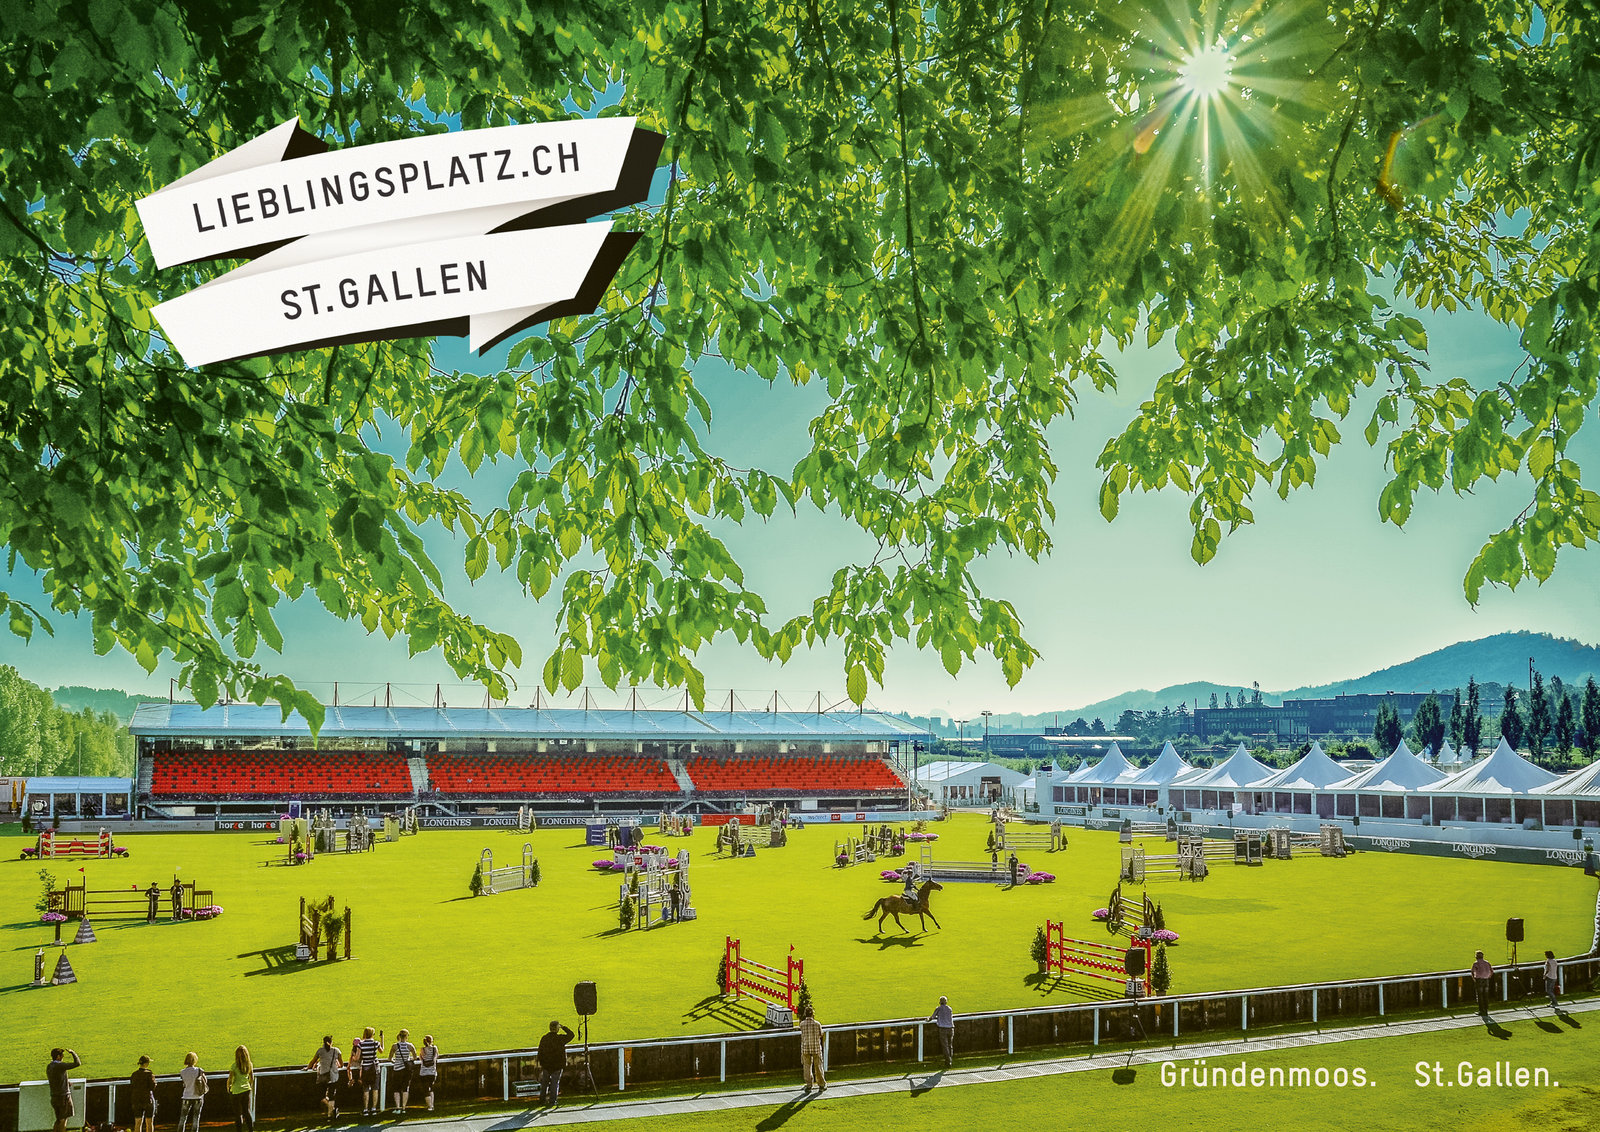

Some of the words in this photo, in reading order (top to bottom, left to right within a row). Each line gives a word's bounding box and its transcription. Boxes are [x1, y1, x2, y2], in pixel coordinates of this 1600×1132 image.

[218, 821, 243, 830] horze
[251, 821, 276, 830] horze
[423, 818, 472, 827] LONGINES
[483, 817, 518, 826] LONGIN
[541, 817, 586, 826] LONGINES
[1371, 837, 1411, 849] LONGINES
[1452, 843, 1497, 855] LONGINES
[1144, 927, 1149, 935] 2
[782, 1013, 790, 1022] A
